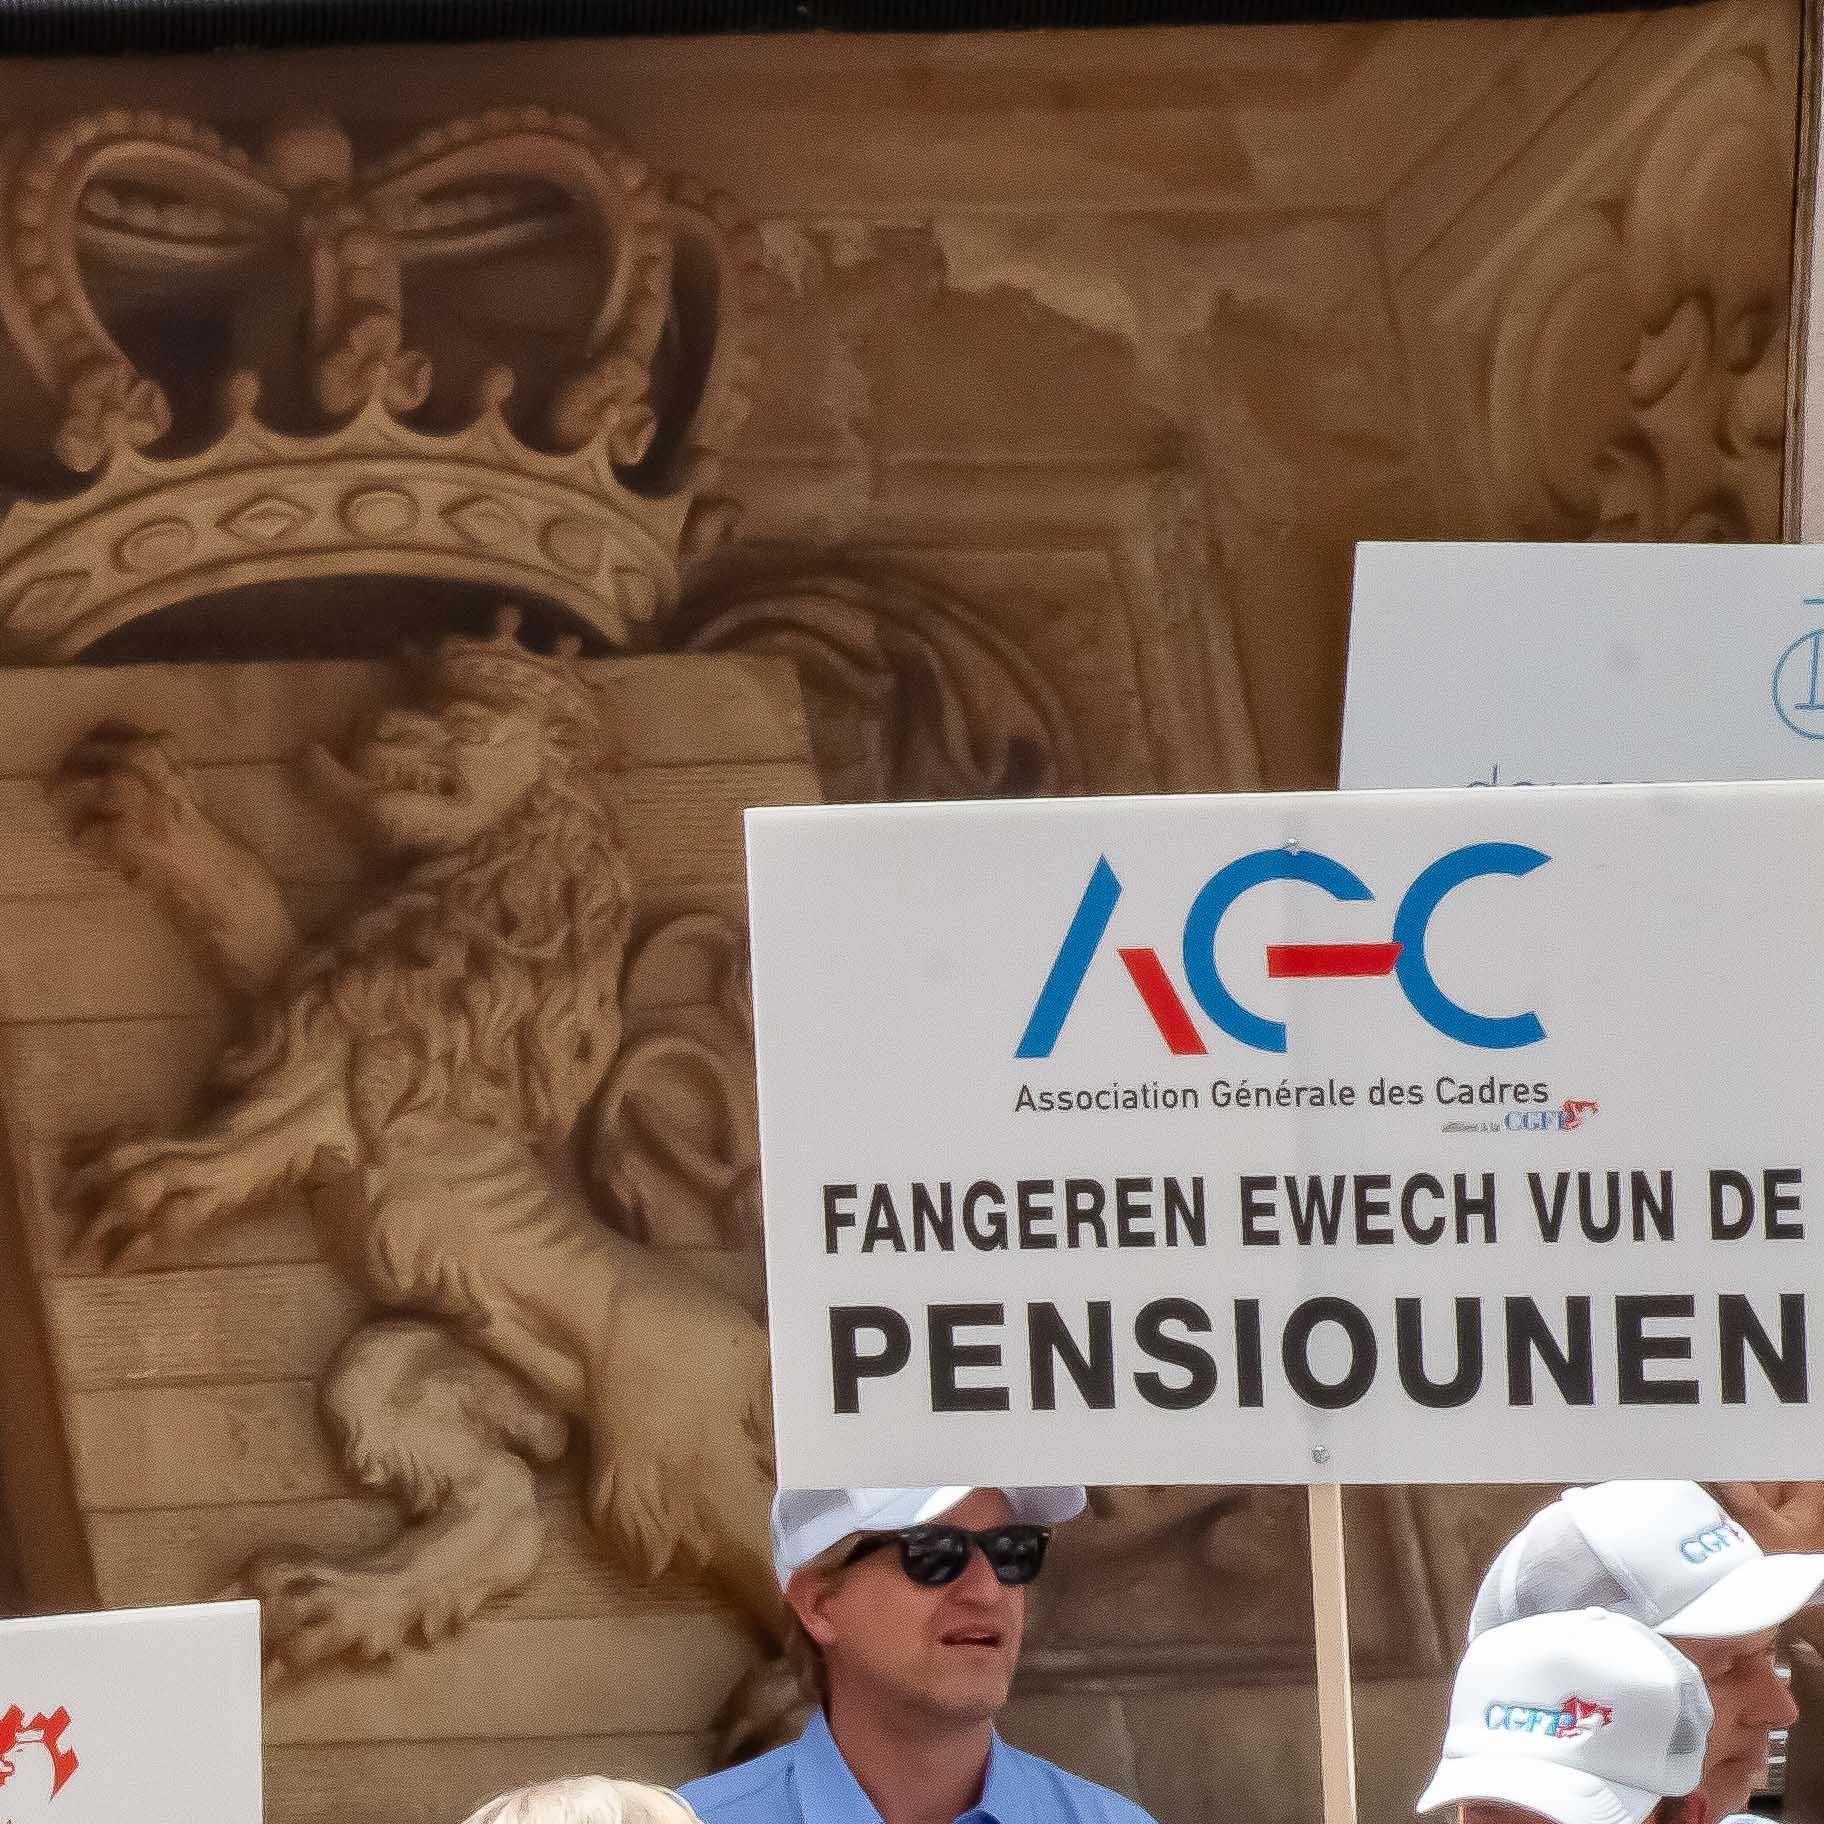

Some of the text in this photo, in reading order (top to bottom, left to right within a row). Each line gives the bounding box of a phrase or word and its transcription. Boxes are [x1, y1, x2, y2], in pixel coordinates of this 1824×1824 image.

[1014, 841, 1552, 1060] AGC
[1014, 1075, 1550, 1114] Association Générale des Cadres
[823, 1168, 1806, 1255] FANGEREN EWECH VUN DE
[828, 1293, 1812, 1416] PENSIOUNEN
[1485, 1703, 1574, 1737] CGFP
